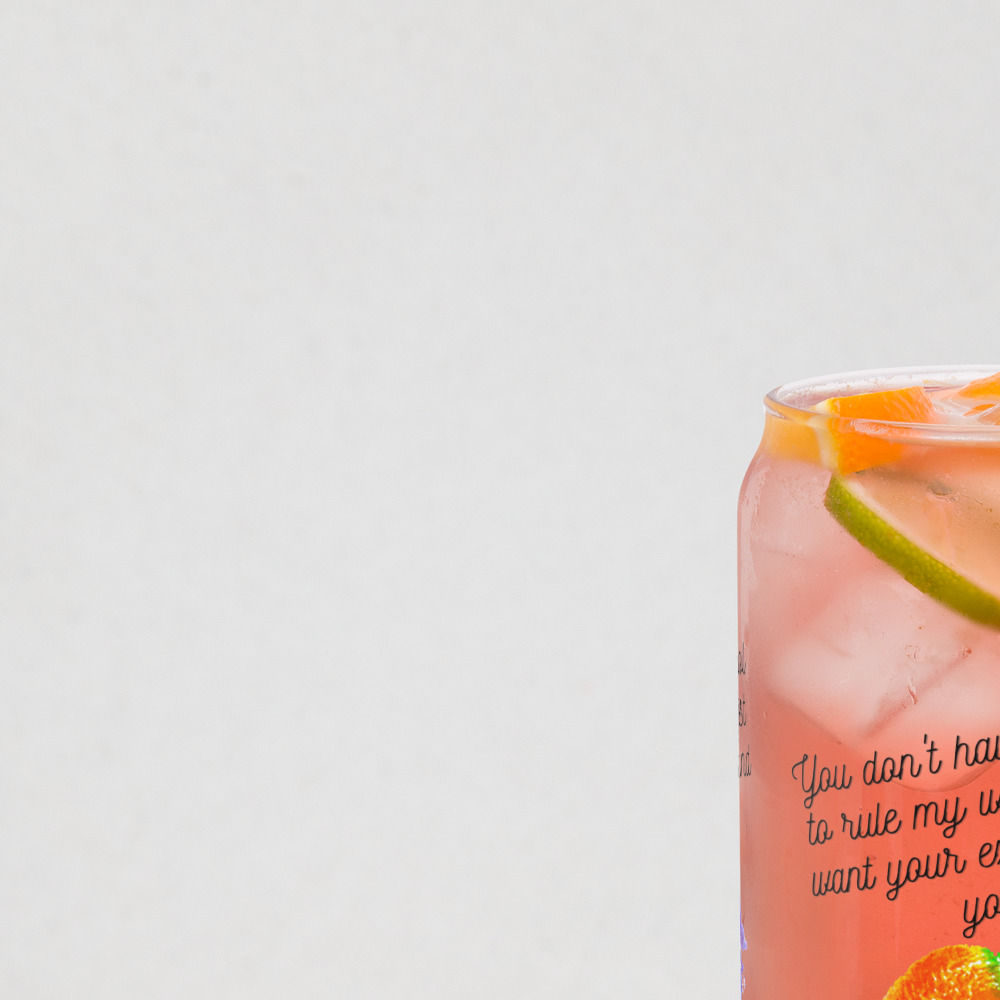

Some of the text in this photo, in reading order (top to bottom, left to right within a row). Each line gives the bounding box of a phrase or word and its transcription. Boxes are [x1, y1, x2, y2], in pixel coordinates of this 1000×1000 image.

[792, 754, 852, 808] You
[863, 734, 942, 785] don't
[806, 812, 833, 846] to
[841, 802, 901, 841] rule
[912, 796, 967, 838] my
[812, 850, 876, 897] want
[887, 848, 966, 901] your
